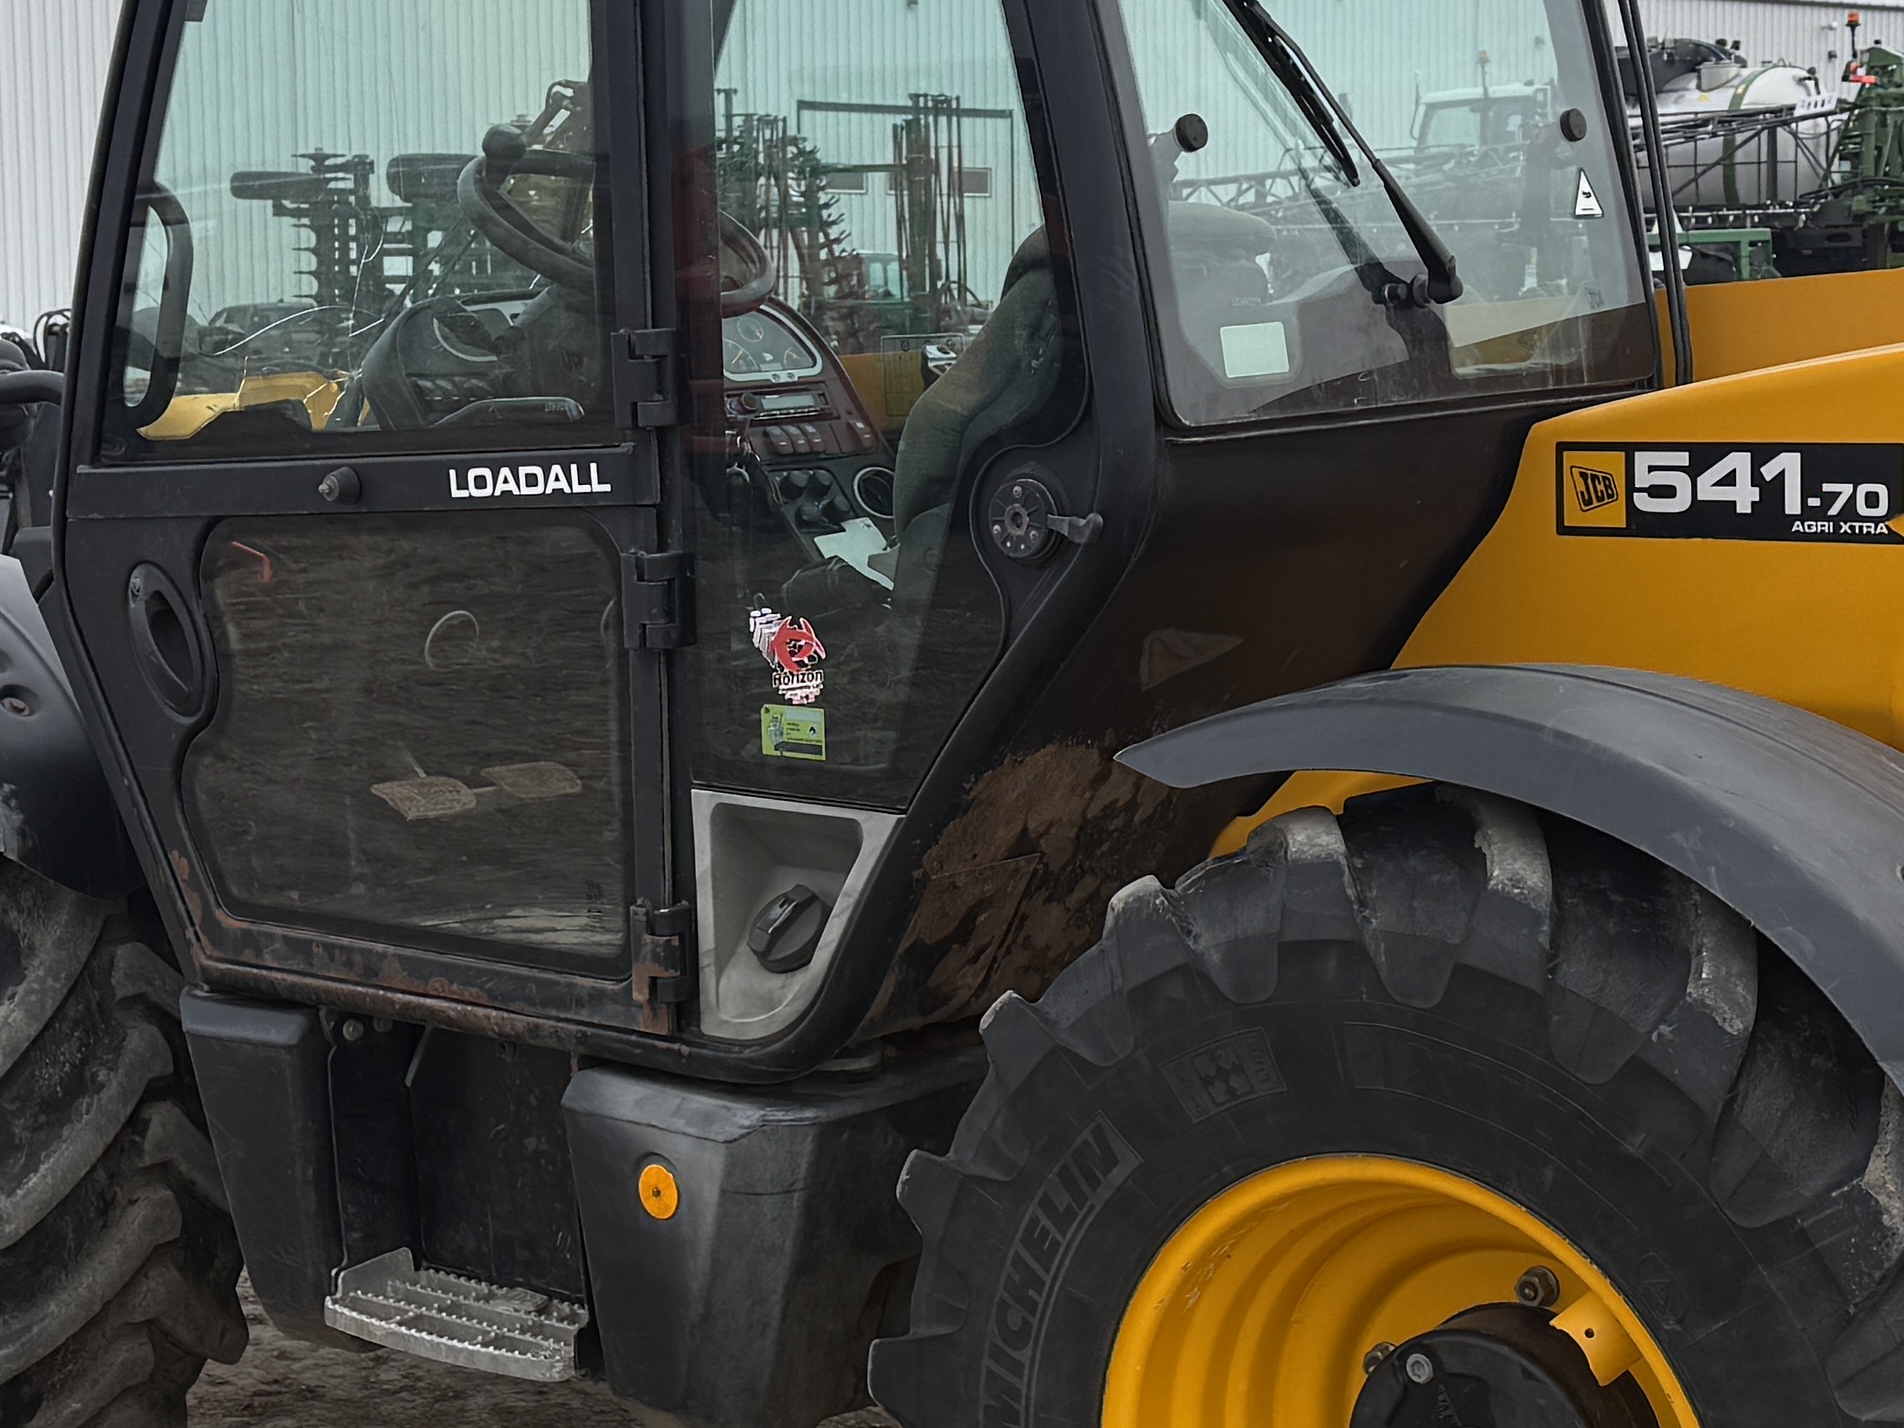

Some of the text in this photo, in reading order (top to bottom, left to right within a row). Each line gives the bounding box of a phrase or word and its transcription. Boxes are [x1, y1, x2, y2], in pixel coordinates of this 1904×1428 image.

[449, 463, 612, 498] LOADALL
[1579, 470, 1615, 507] JCB
[1791, 521, 1889, 535] AGRI XTRA
